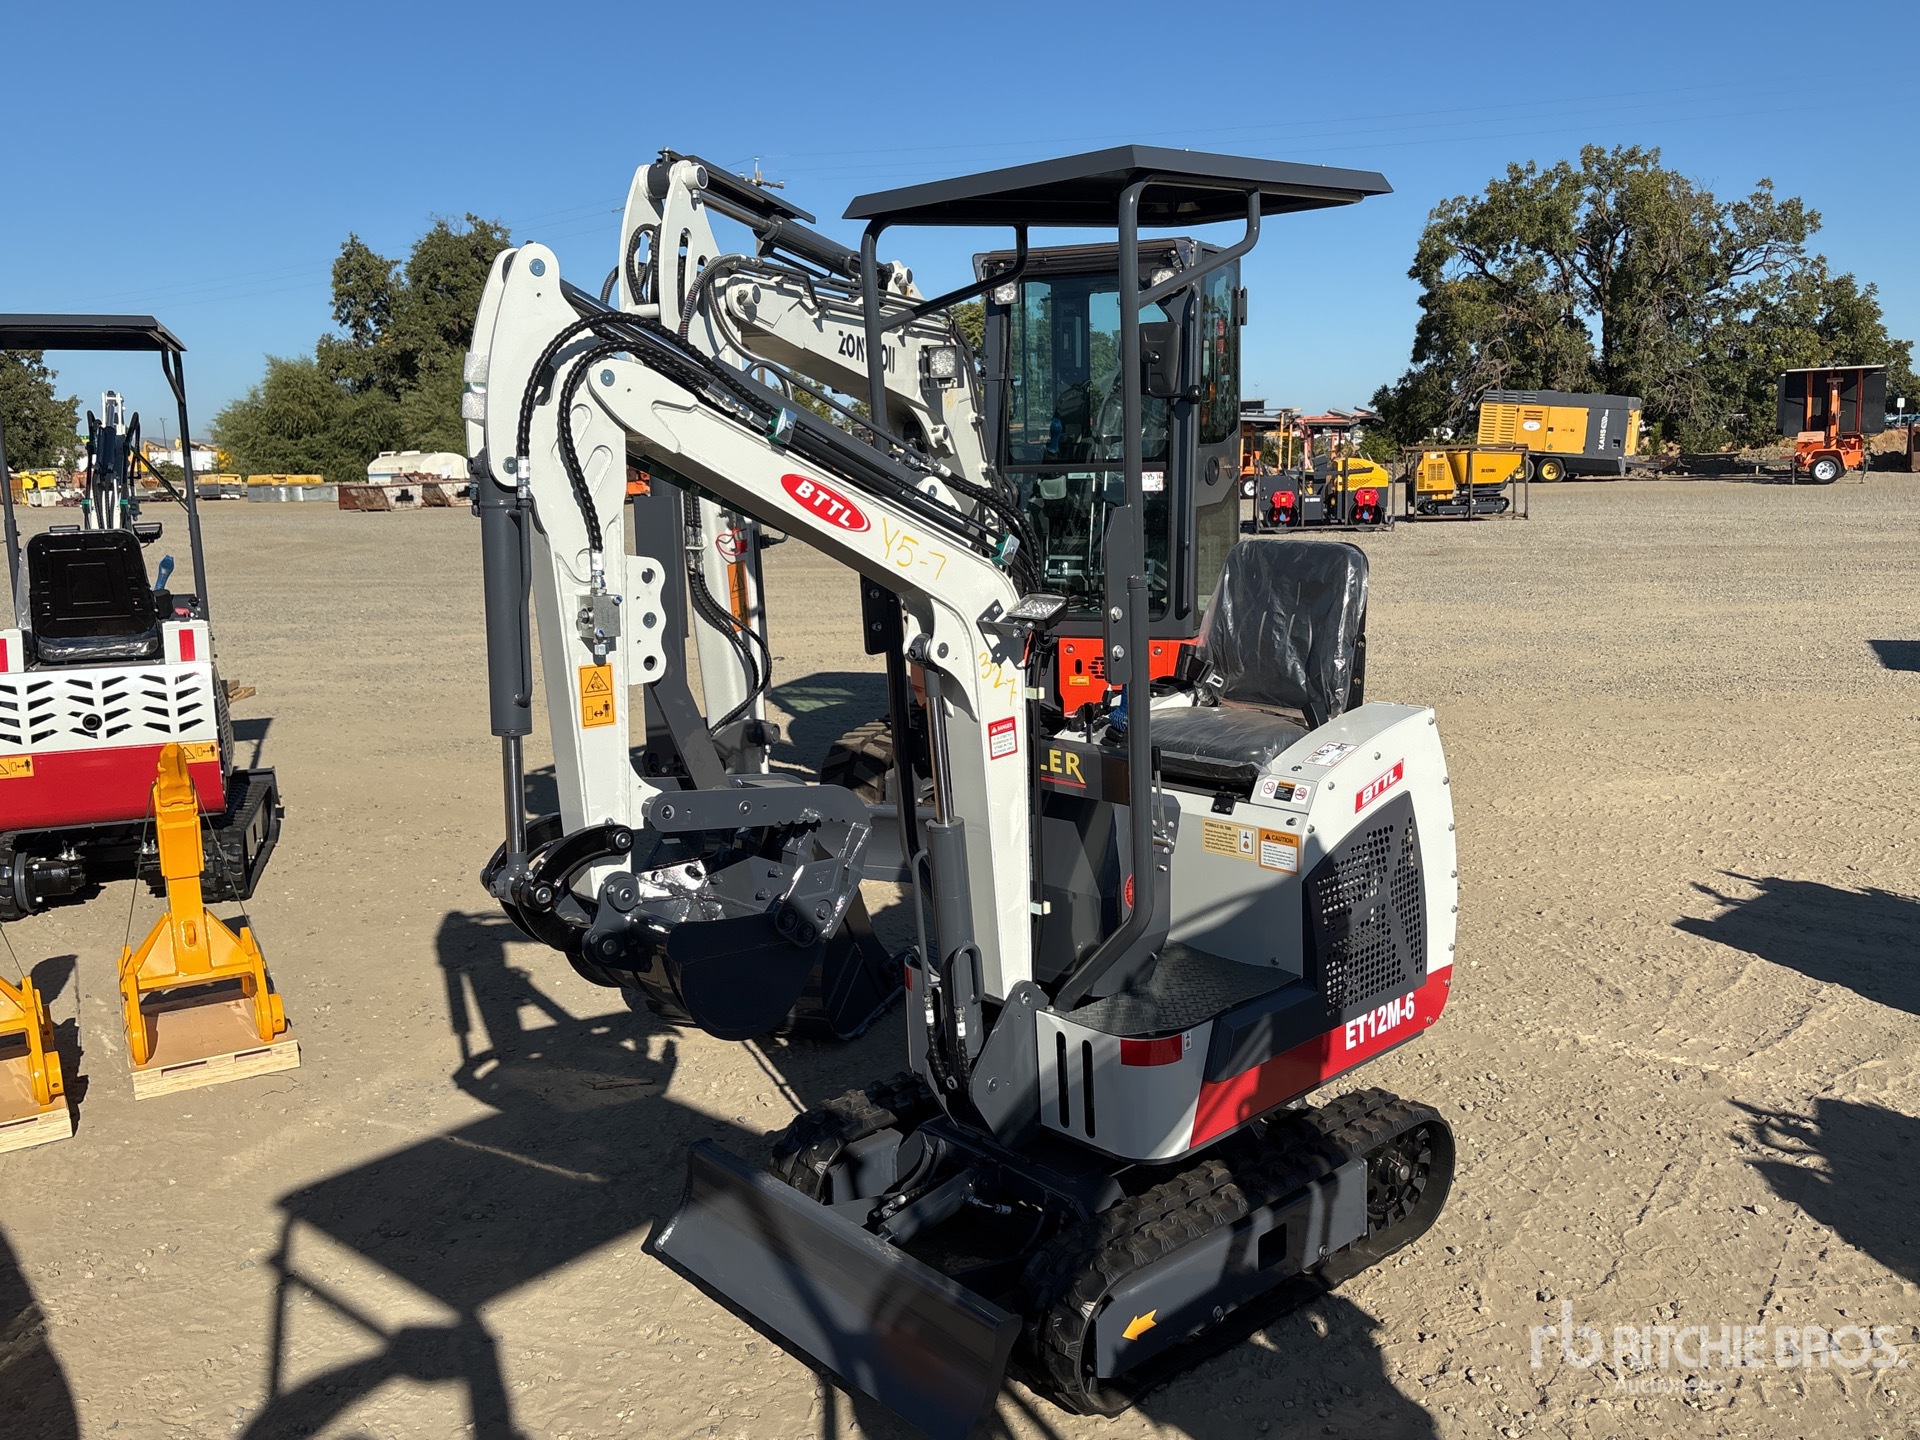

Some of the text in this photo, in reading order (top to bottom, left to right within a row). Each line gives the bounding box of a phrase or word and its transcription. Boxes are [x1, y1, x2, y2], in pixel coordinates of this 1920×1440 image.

[794, 480, 852, 527] BTTL
[882, 517, 947, 580] Y5-7
[979, 652, 1017, 706] 327
[1362, 769, 1398, 803] BTTL
[1271, 834, 1294, 844] CAUTION
[1345, 992, 1415, 1051] ET12M-6
